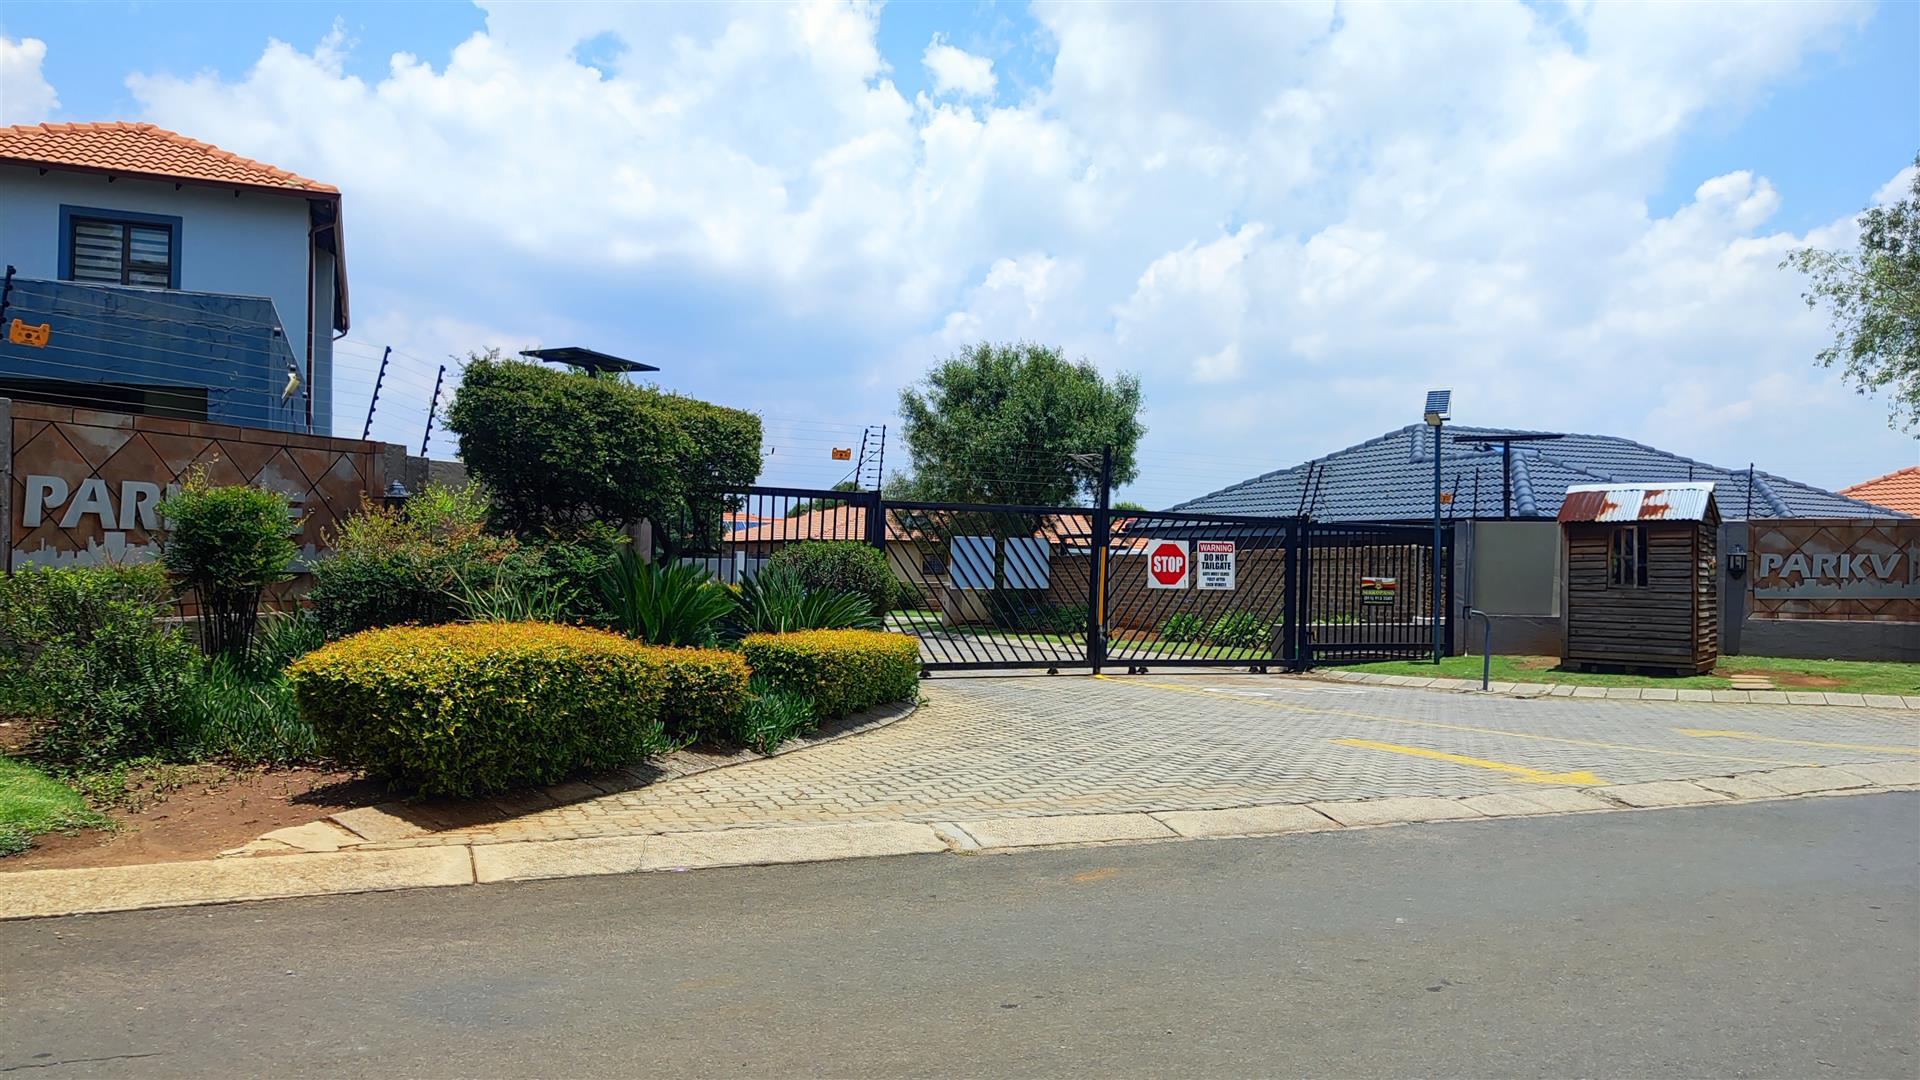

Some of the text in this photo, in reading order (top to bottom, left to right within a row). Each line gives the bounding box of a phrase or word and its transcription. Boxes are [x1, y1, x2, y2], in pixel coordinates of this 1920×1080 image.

[1200, 544, 1232, 552] WARNING
[1153, 556, 1183, 573] STOP
[1201, 562, 1231, 570] TAILGATE
